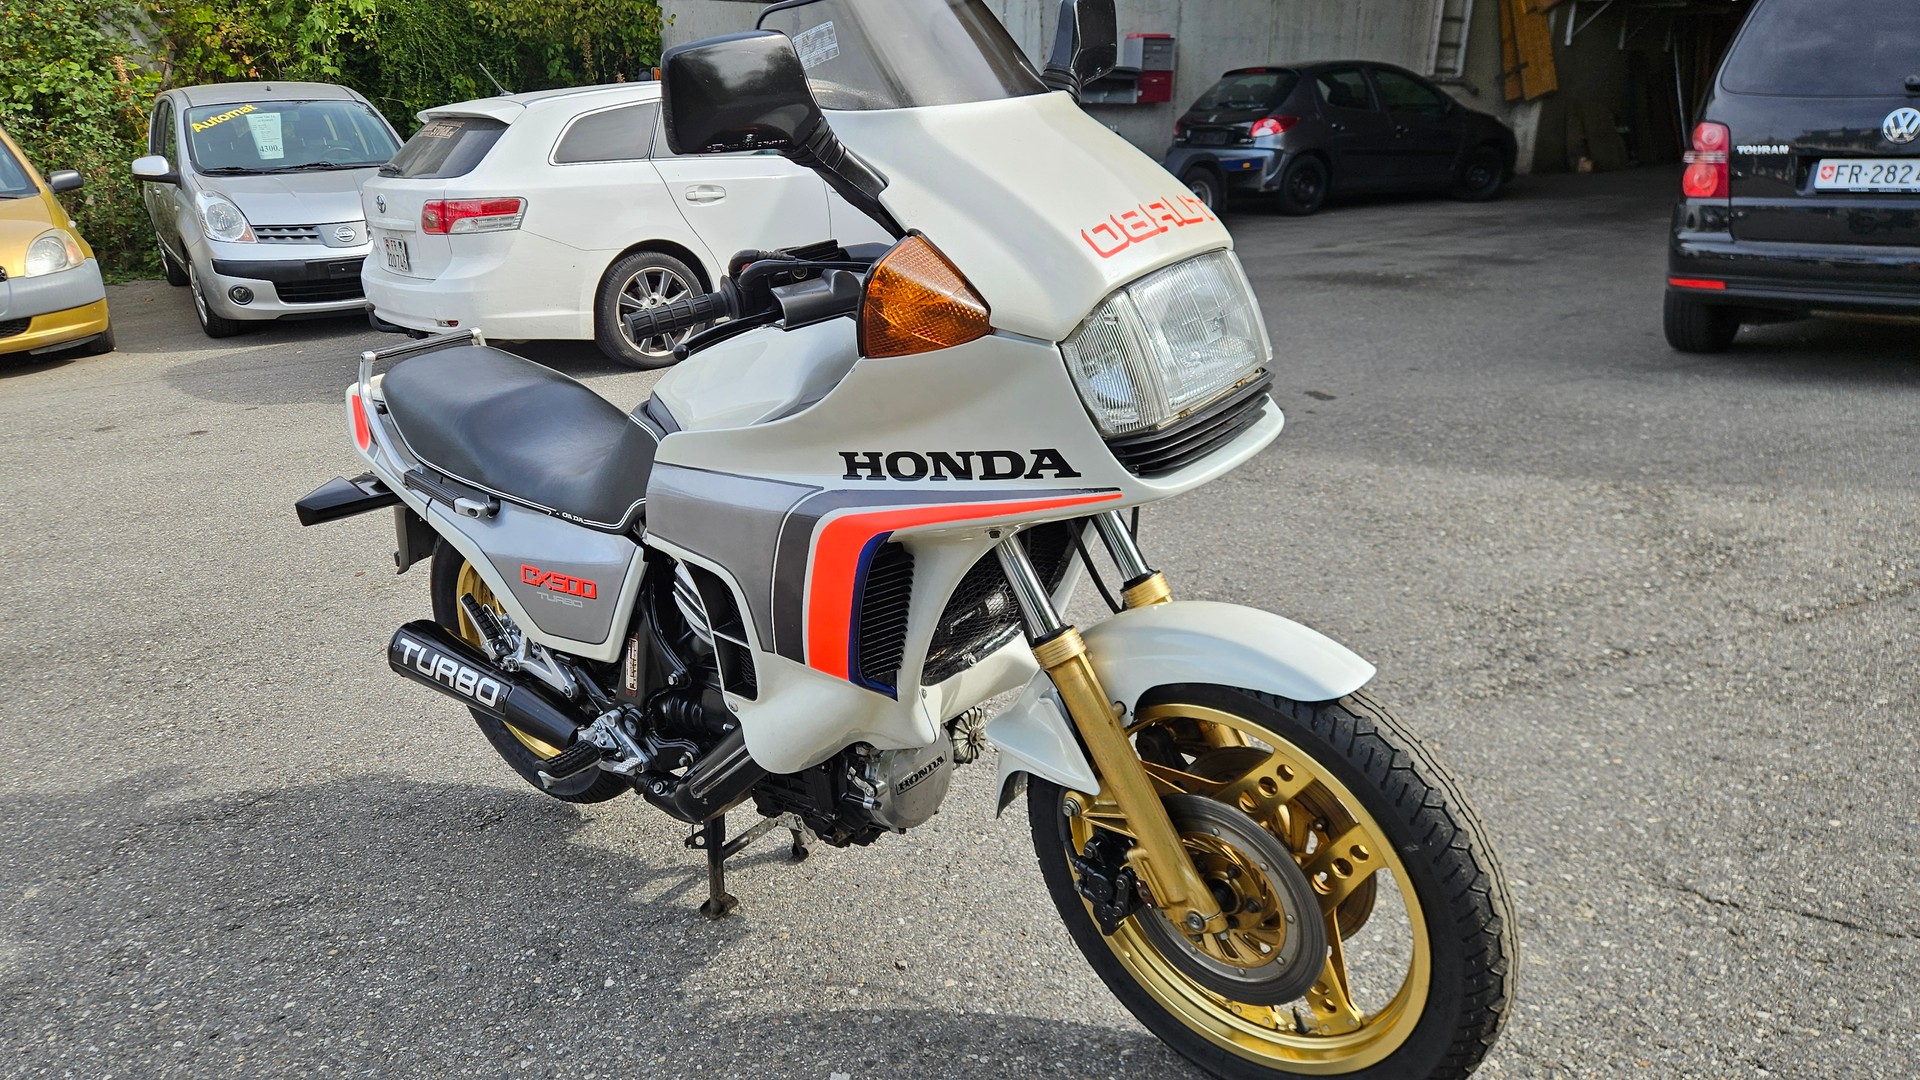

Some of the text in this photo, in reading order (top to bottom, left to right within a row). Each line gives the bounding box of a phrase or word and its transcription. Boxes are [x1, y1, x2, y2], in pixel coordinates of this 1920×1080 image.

[191, 103, 258, 133] Automat
[1736, 144, 1790, 155] TOURAN
[839, 448, 1082, 482] HONDA
[521, 564, 597, 600] CX500
[536, 591, 584, 609] TURBO
[399, 637, 501, 708] TURBO
[898, 755, 945, 791] HONDA
